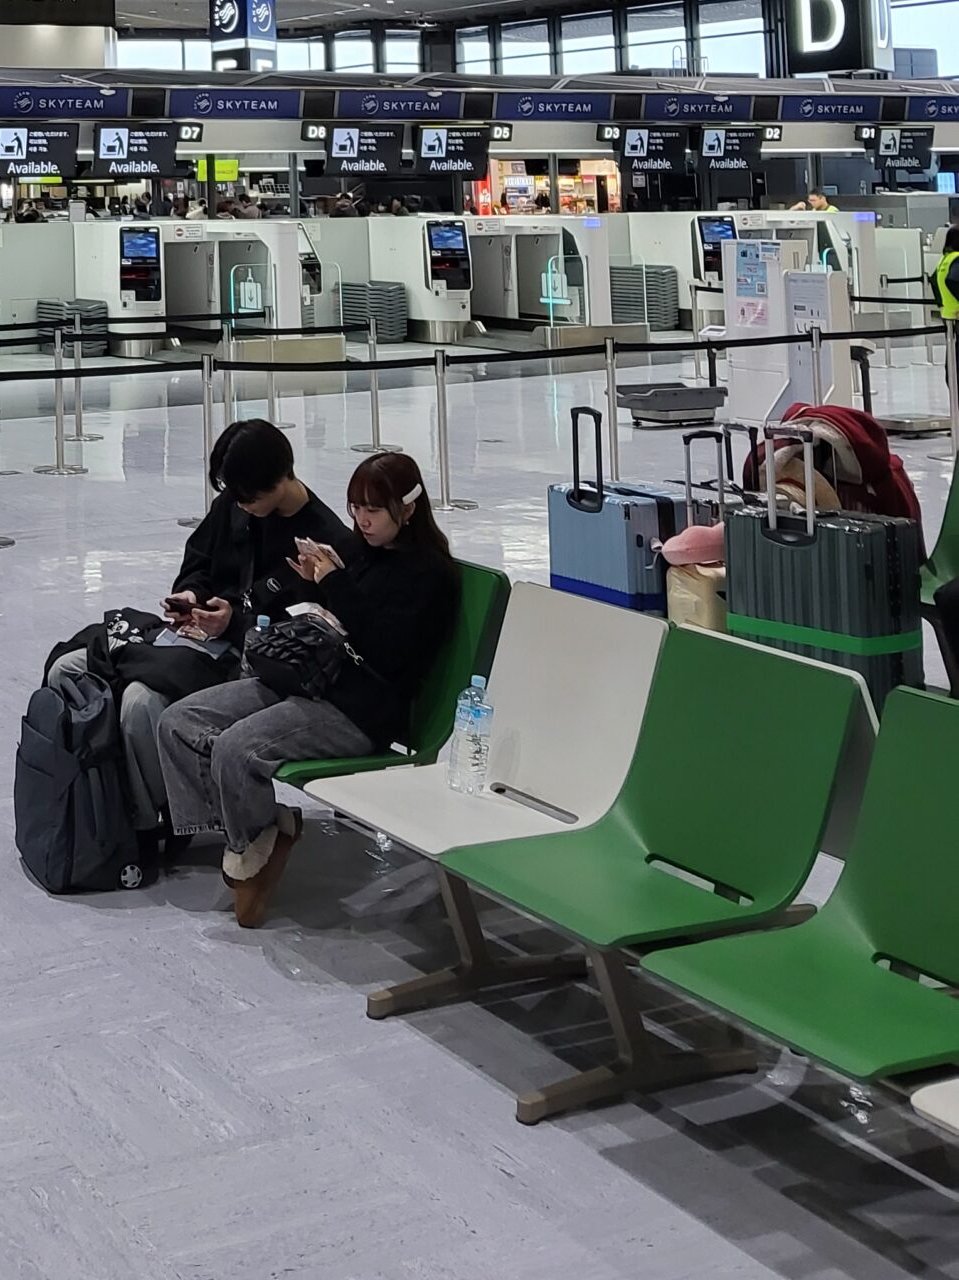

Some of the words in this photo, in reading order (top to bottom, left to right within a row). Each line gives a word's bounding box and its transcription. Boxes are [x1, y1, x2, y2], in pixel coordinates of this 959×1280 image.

[38, 99, 104, 109] SKYTEAM
[216, 100, 278, 110] SKYTEAM
[382, 102, 440, 111] SKYTEAM
[538, 103, 592, 113] SKYTEAM
[683, 104, 733, 113] SKYTEAM
[817, 105, 863, 113] SKYTEAM
[181, 127, 201, 139] D7
[308, 126, 327, 139] D6
[493, 127, 509, 139] D5
[604, 128, 620, 139] D3
[766, 128, 780, 139] D2
[862, 128, 875, 139] D1
[7, 162, 60, 174] Available.
[109, 161, 160, 173] Available.
[341, 159, 387, 172] Available.
[430, 159, 474, 171] Available.
[632, 158, 673, 170] Available.
[709, 158, 749, 169] Available.
[886, 158, 921, 168] Available.
